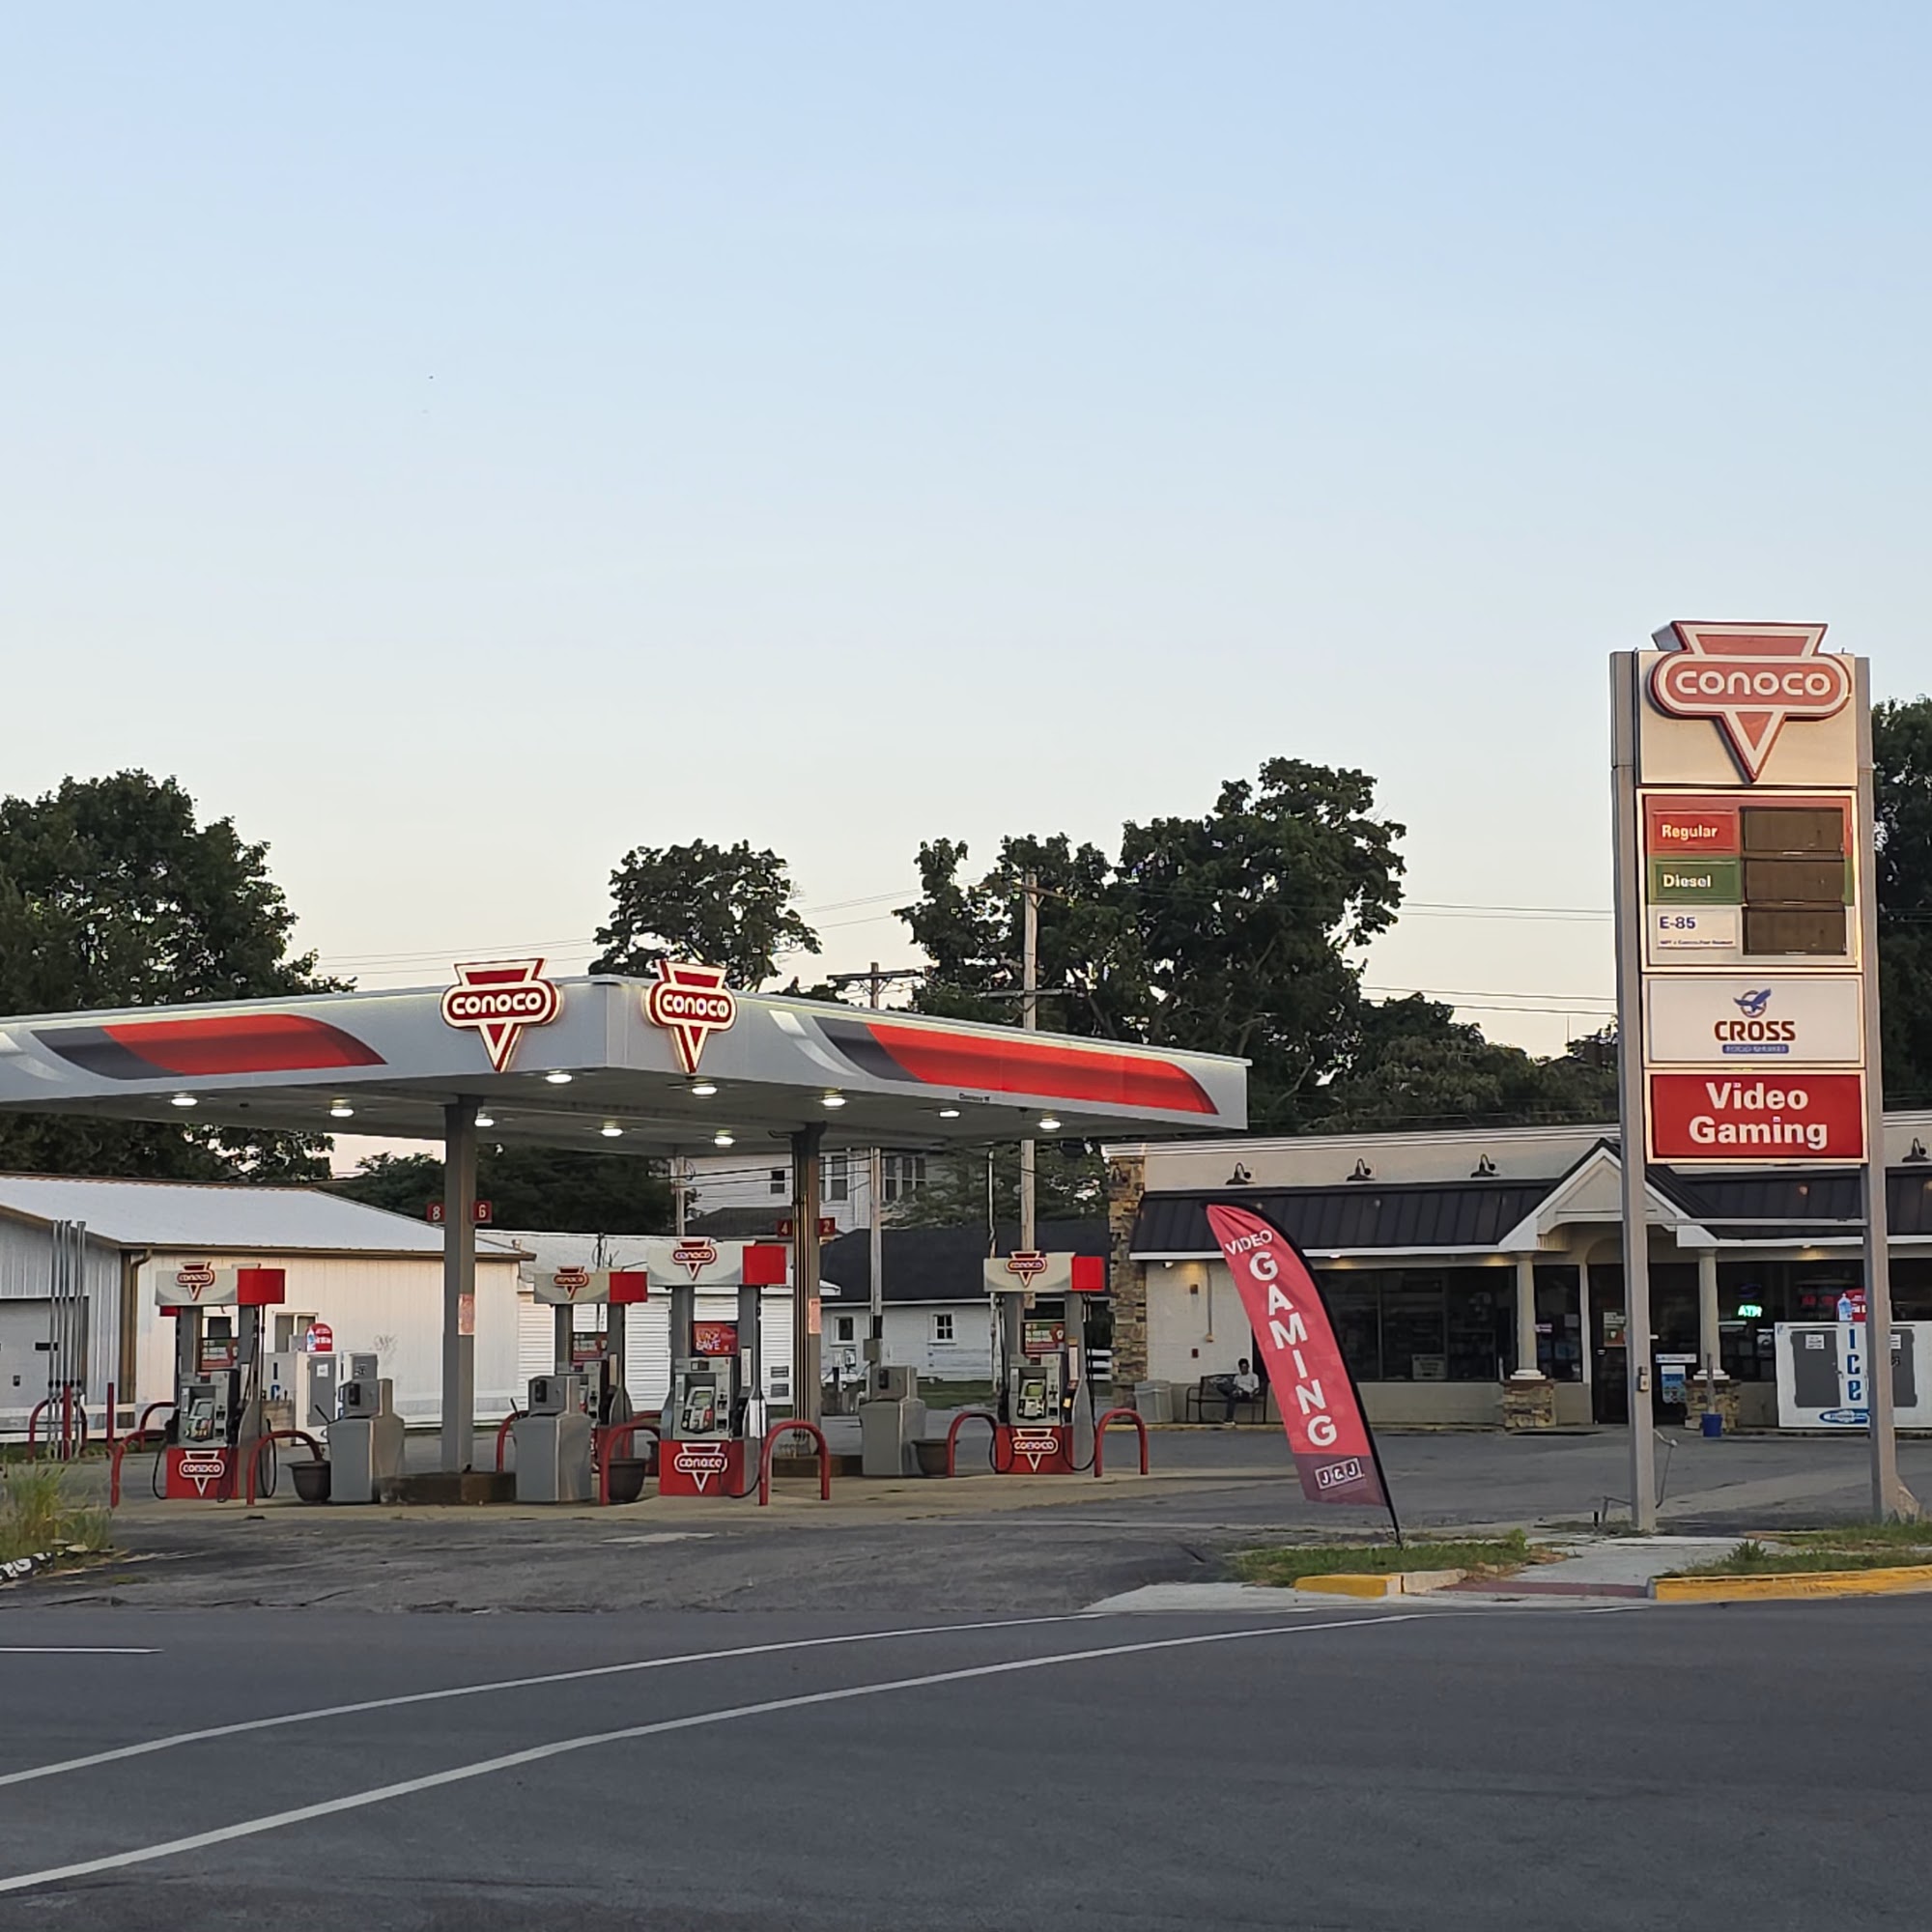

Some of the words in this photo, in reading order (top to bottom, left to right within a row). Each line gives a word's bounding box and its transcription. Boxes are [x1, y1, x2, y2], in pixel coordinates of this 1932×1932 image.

[1662, 824, 1718, 840] Regular
[1662, 874, 1712, 888] Diesel
[1659, 916, 1696, 929] E-85
[1714, 1020, 1796, 1041] CROSS
[1705, 1082, 1808, 1110] Video
[1689, 1116, 1828, 1151] Gaming
[432, 1205, 441, 1221] 8
[477, 1204, 487, 1219] 6
[781, 1221, 789, 1235] 4
[1225, 1230, 1272, 1256] VIDEO
[1249, 1251, 1337, 1447] GAMING
[1319, 1461, 1358, 1486] J&J
